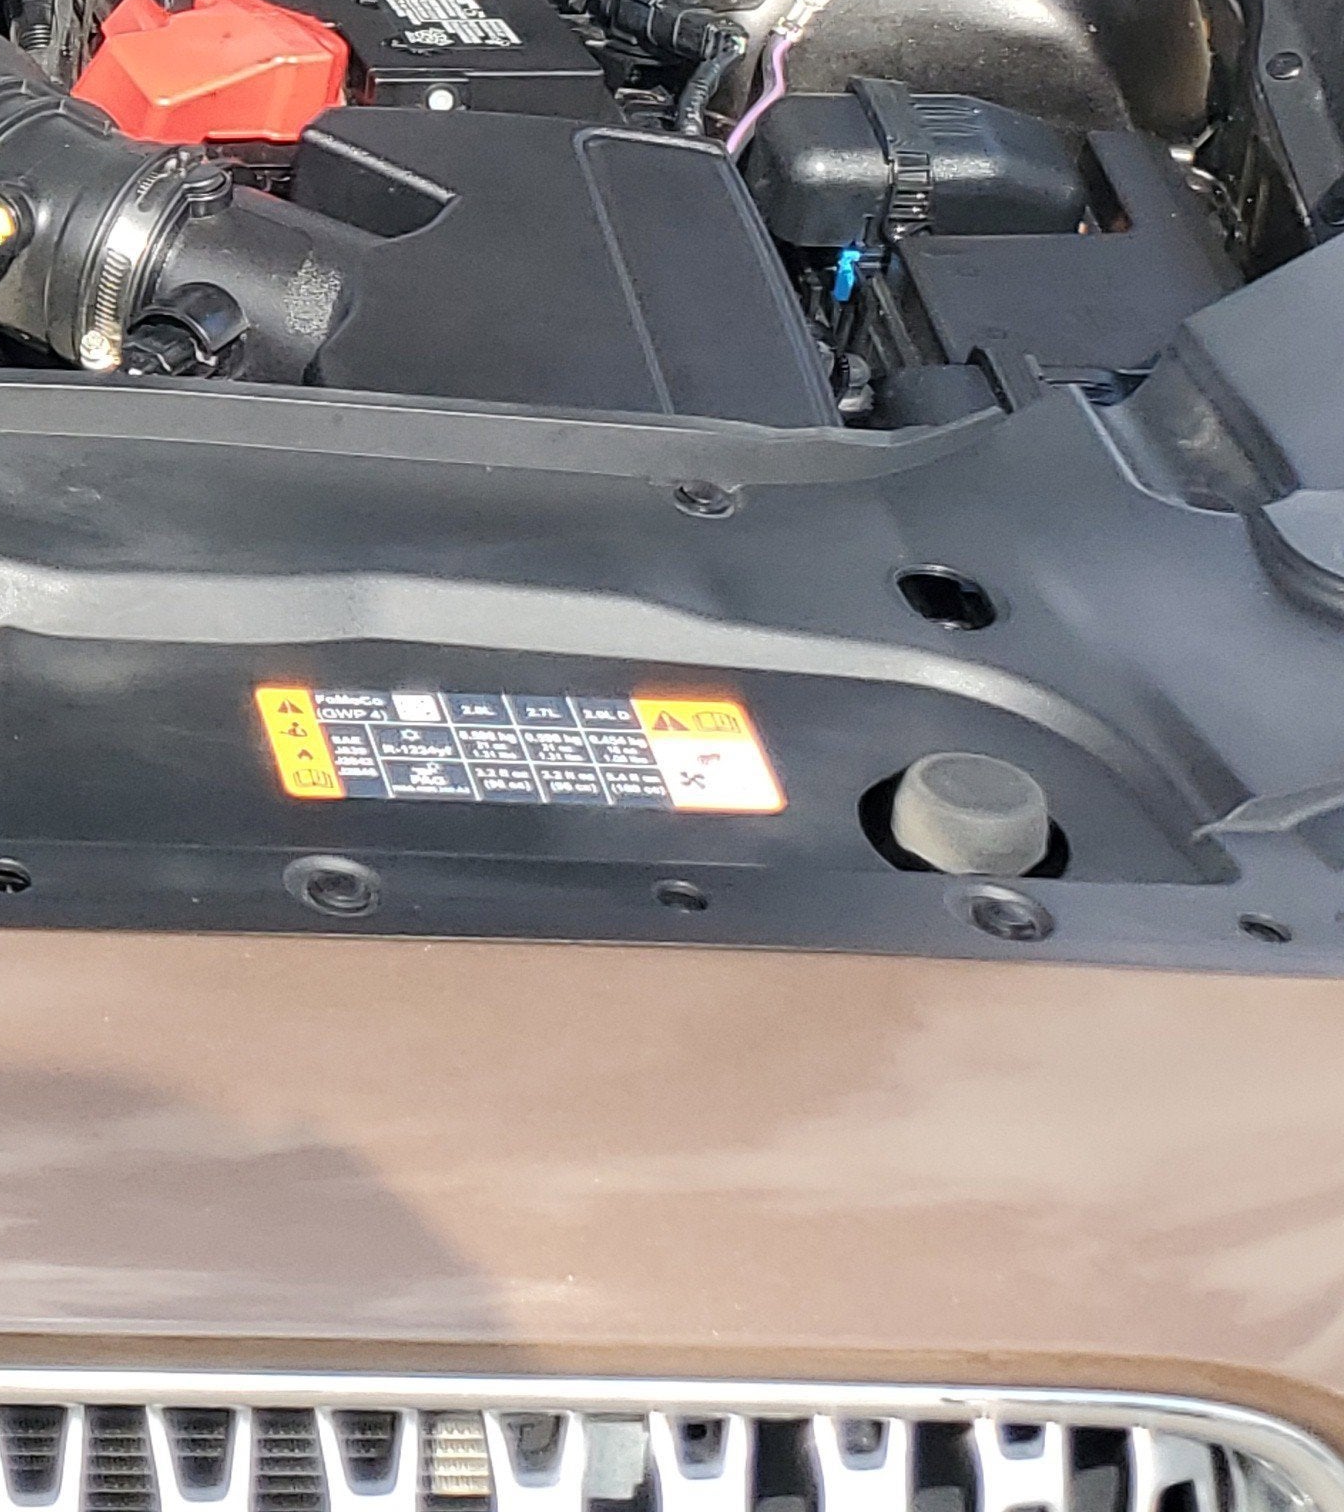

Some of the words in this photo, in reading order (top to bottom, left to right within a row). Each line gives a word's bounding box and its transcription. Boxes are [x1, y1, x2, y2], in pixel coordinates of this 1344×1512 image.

[317, 707, 368, 721] (GWP
[369, 708, 389, 722] 4)
[525, 707, 562, 719] 2.7L
[382, 743, 453, 757] R-1234yf
